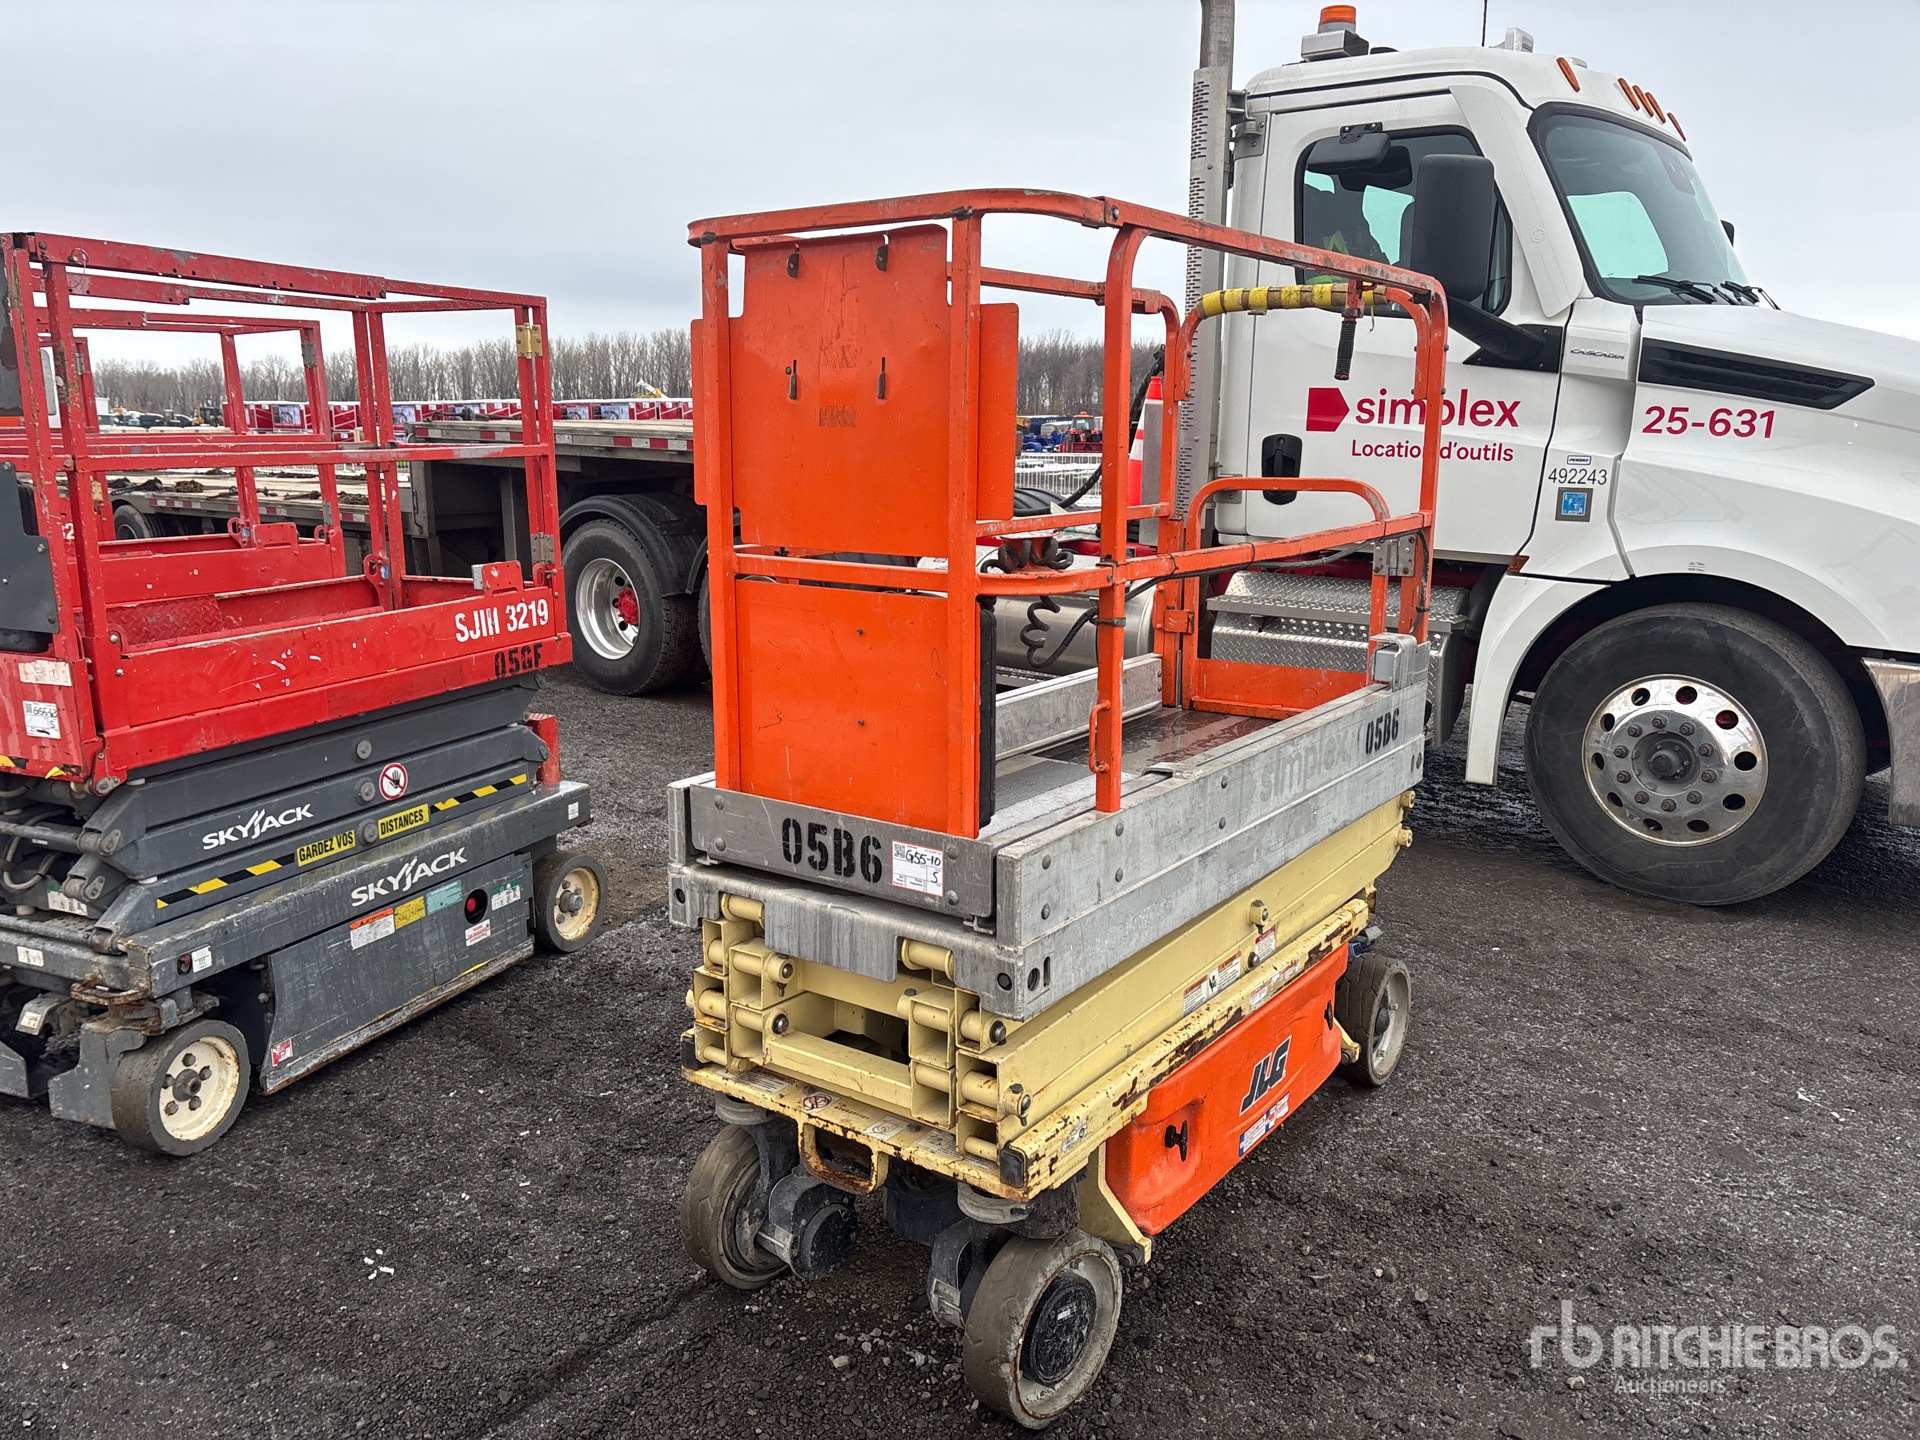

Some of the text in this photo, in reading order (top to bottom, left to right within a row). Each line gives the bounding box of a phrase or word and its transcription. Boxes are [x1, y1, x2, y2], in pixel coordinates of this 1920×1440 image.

[1570, 348, 1625, 359] CASCADIA
[1642, 405, 1776, 439] 25-631
[1352, 439, 1425, 458] Locatio
[1548, 467, 1608, 486] 492243
[505, 598, 549, 632] 3219
[1365, 707, 1400, 755] 05B6
[202, 803, 314, 850] SKYJACK
[299, 809, 425, 862] GARDEZ VOS DISTANCES
[782, 818, 883, 884] 05B6
[351, 846, 468, 907] SKYJACK
[1239, 1035, 1292, 1117] JLG
